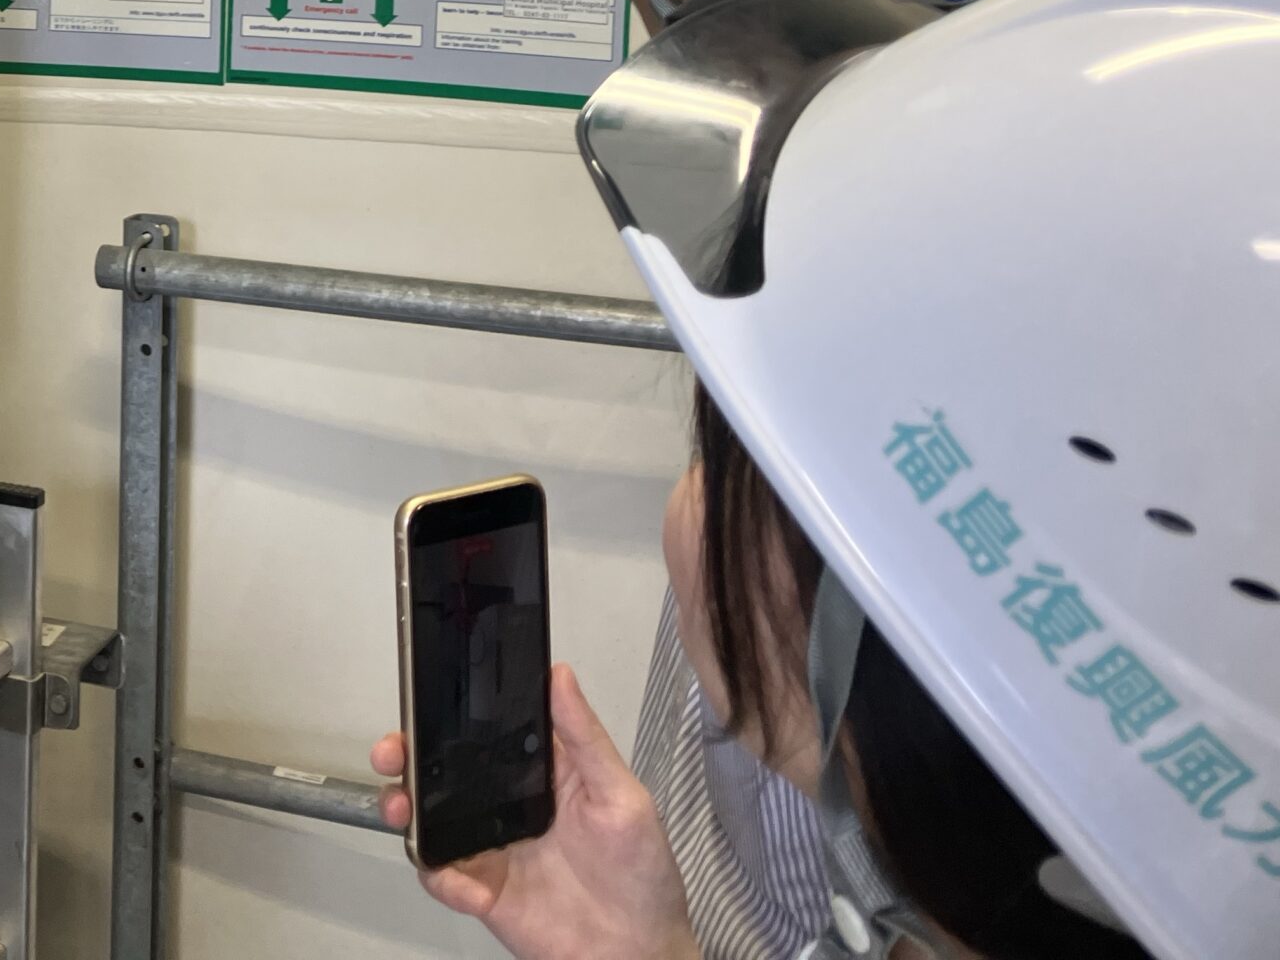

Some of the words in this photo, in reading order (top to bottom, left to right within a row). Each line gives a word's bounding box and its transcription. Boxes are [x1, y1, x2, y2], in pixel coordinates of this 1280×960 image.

[575, 0, 609, 9] Hospital
[304, 5, 344, 15] Emergency
[345, 7, 359, 15] call
